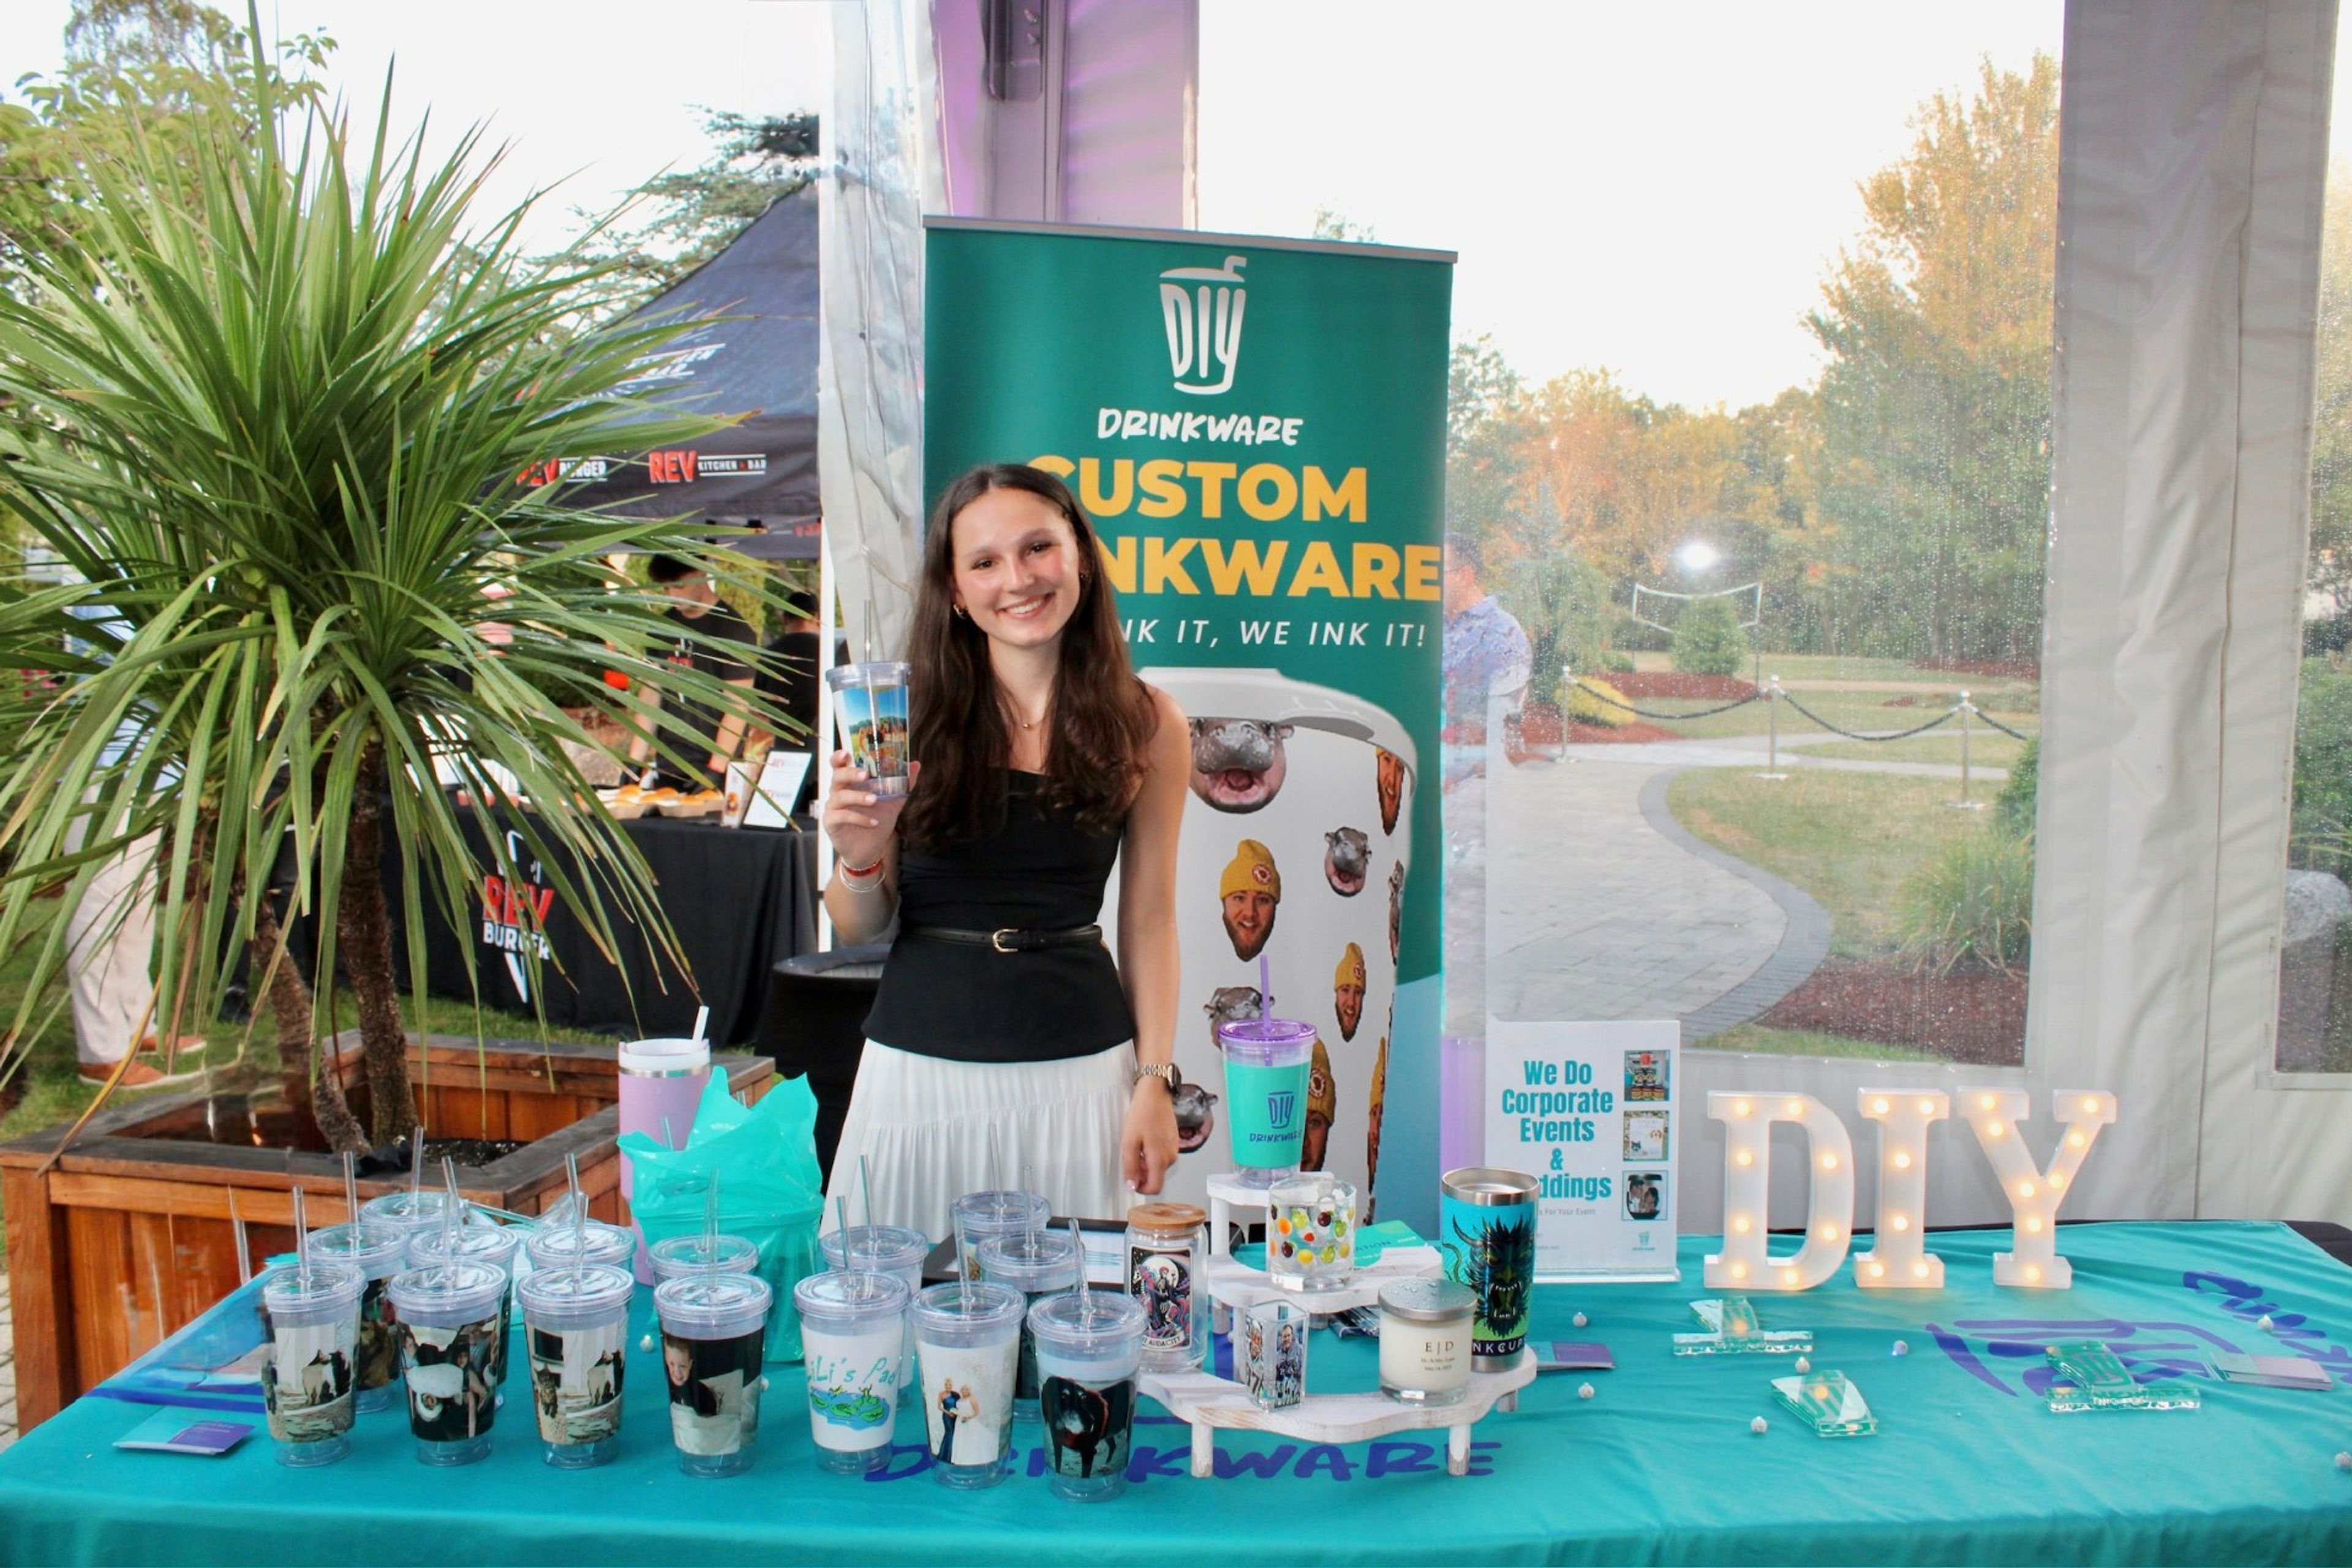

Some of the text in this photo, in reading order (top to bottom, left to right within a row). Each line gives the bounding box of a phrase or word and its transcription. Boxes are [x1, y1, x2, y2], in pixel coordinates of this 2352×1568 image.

[1159, 284, 1246, 394] DIY
[1098, 407, 1303, 446] DRINKWARE
[649, 451, 767, 483] REV KITCHEN BAR
[1094, 535, 1441, 601] NKWARE
[1177, 620, 1218, 647] IT,
[1240, 621, 1291, 645] WE
[1309, 622, 1370, 646] INK
[1385, 624, 1426, 646] IT!
[1523, 1060, 1592, 1085] We Do
[1267, 1094, 1294, 1129] DIY
[1502, 1088, 1614, 1117] Corporate
[1520, 1117, 1595, 1142] Events
[1550, 1148, 1564, 1170] &
[1538, 1173, 1612, 1201] ddings
[1703, 1085, 2117, 1291] DIY
[1472, 1338, 1524, 1354] NKCUP
